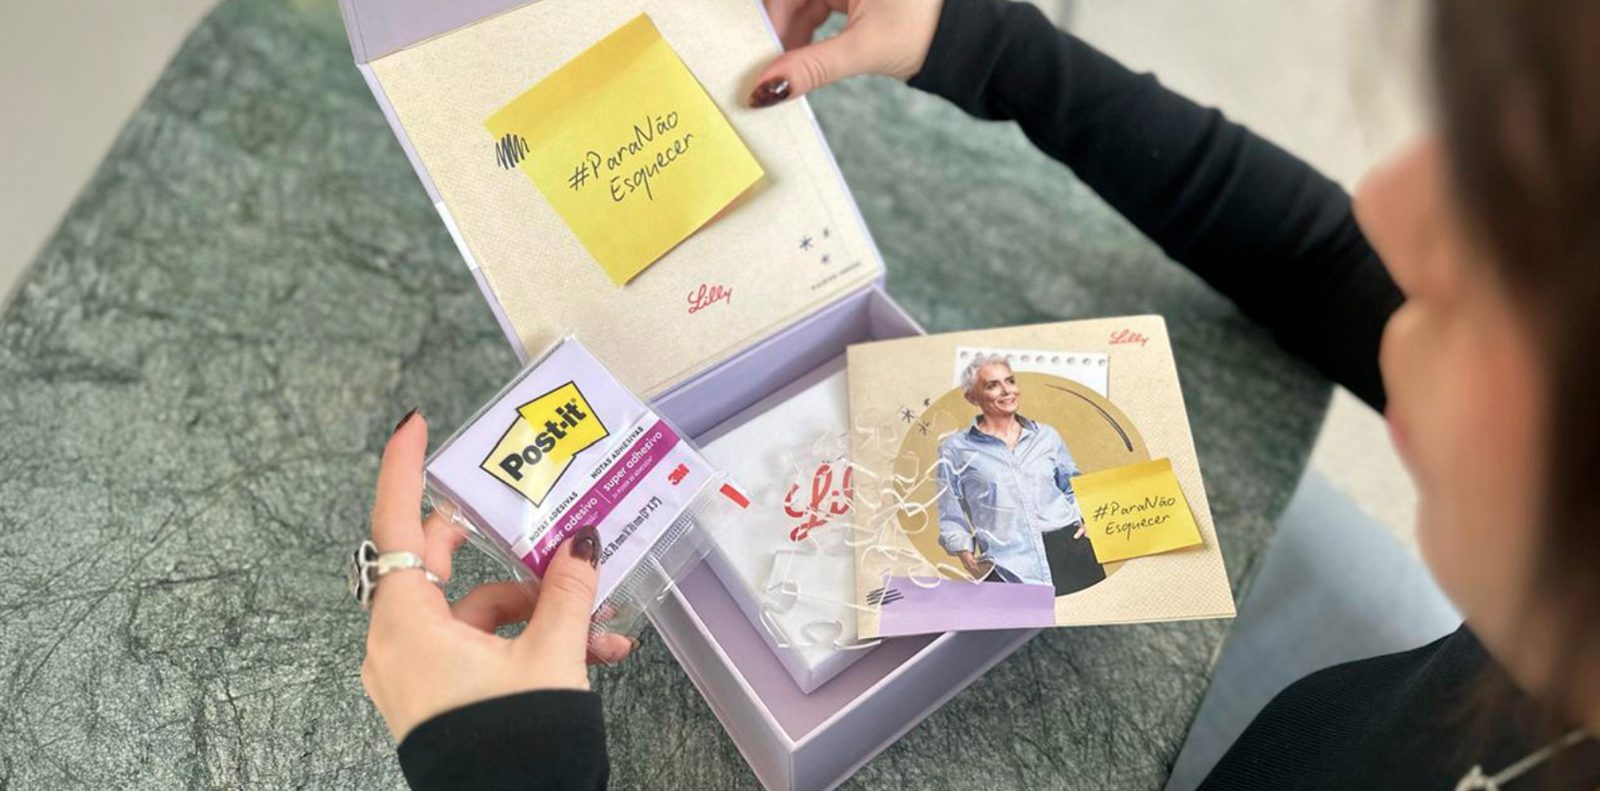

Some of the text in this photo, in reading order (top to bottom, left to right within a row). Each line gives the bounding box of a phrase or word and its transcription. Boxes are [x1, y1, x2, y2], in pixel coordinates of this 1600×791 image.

[568, 111, 679, 190] #ParaNão
[610, 133, 694, 202] Esquecer
[687, 283, 732, 314] Lilly
[1108, 328, 1149, 347] Lilly
[590, 426, 644, 479] NOTAS ADHESIVAS
[603, 432, 663, 492] super adhesivo
[668, 463, 690, 485] 3M
[529, 520, 549, 542] NOTAS
[549, 491, 578, 522] ADESIVAS
[541, 530, 565, 557] super
[564, 497, 598, 532] adesivo
[1093, 496, 1176, 521] #ParaNão
[1105, 514, 1170, 540] Esquecer
